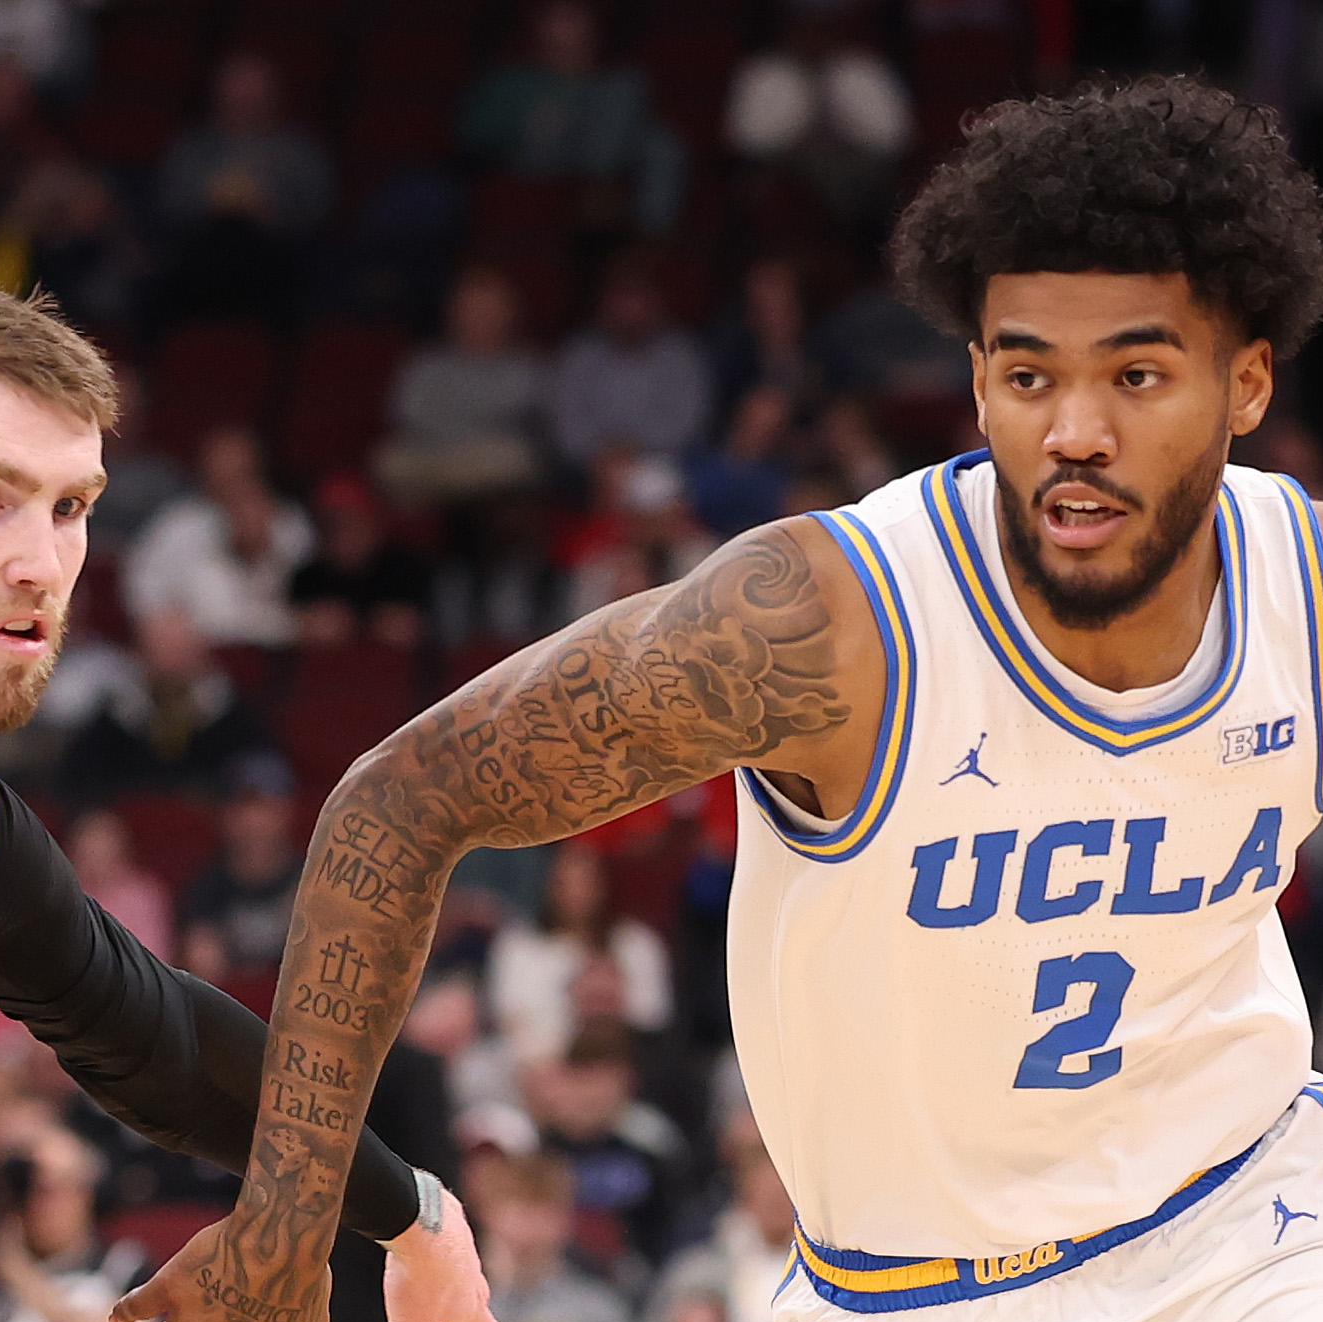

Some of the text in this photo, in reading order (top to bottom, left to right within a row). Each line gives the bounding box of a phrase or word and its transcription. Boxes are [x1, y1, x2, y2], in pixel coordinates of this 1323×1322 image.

[459, 718, 535, 819] Best
[331, 811, 423, 876] SELF
[906, 806, 1283, 929] UCLA
[314, 847, 406, 920] MADE
[294, 983, 371, 1033] 2003
[1013, 951, 1136, 1090] 2
[282, 1037, 351, 1091] Risk
[267, 1077, 355, 1134] Taker
